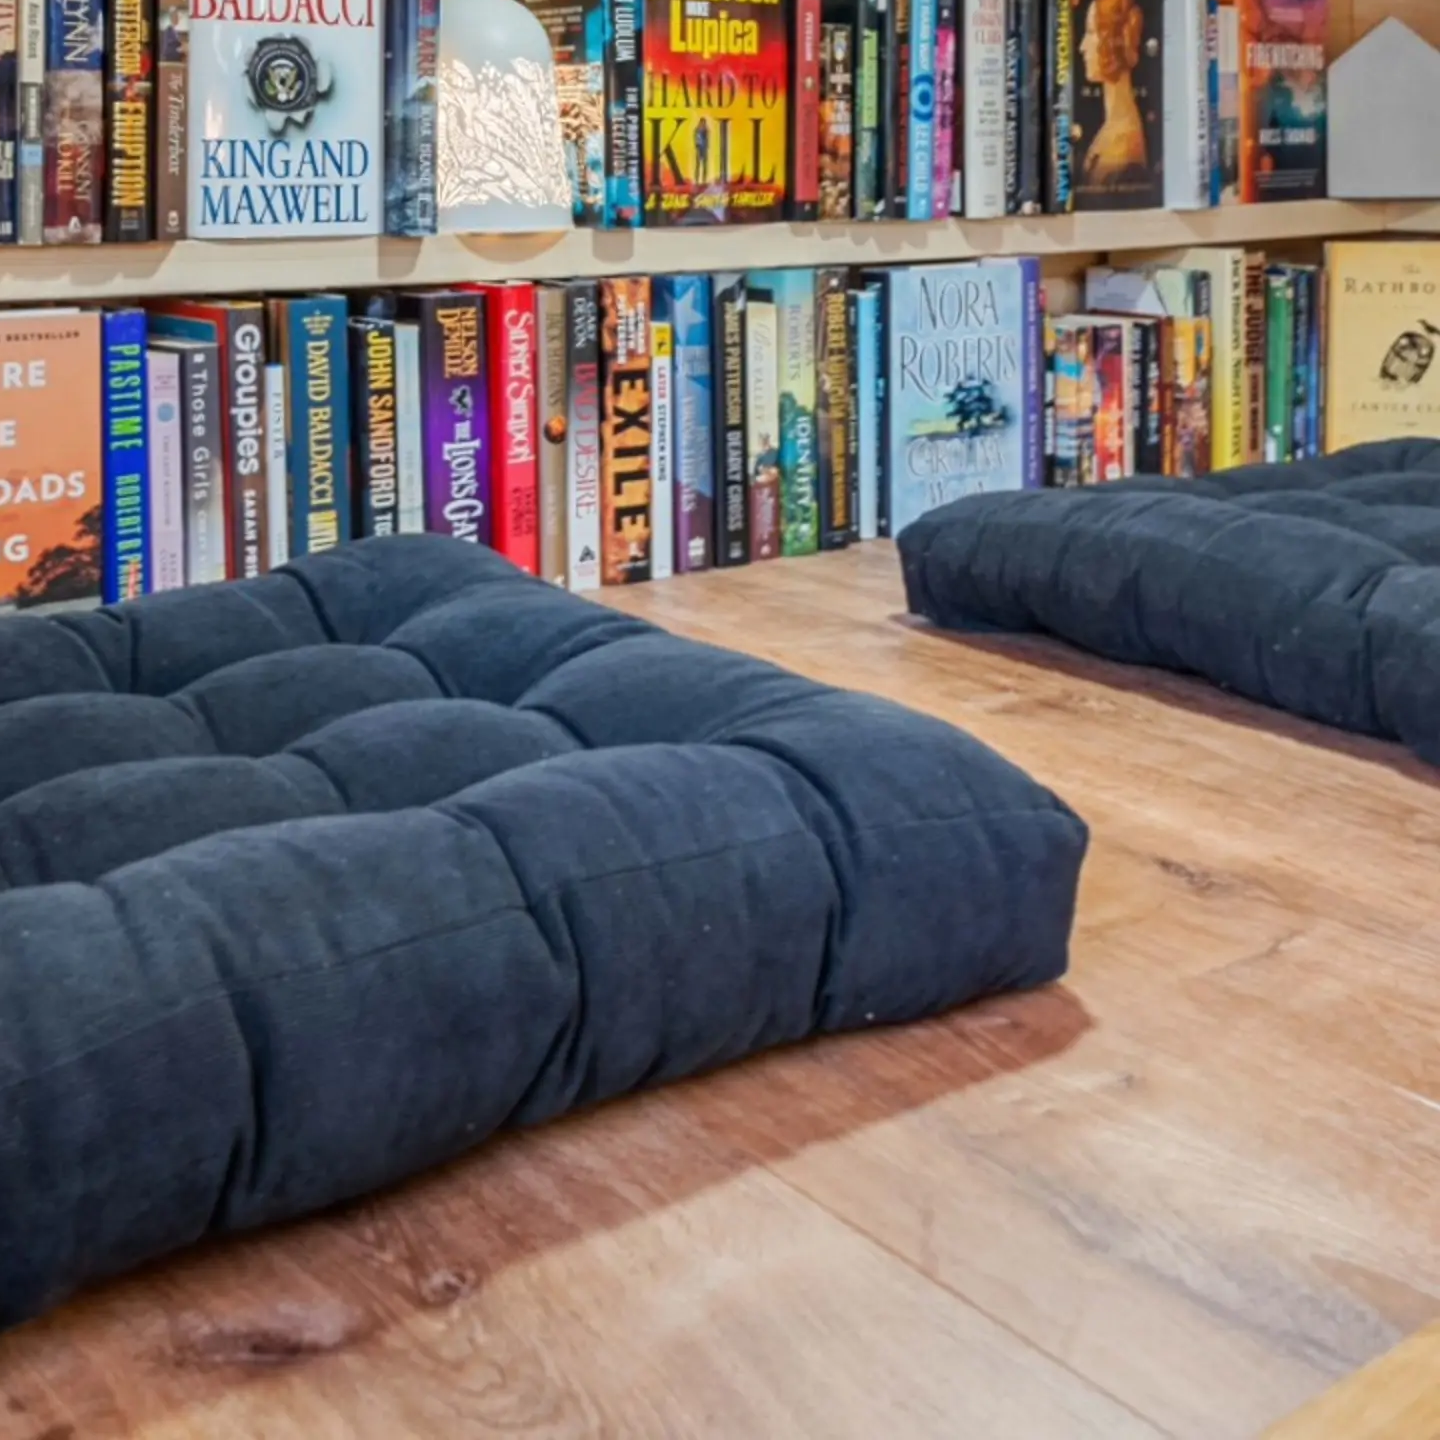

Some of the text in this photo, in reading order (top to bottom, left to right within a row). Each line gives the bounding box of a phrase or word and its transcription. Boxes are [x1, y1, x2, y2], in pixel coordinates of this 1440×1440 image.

[417, 26, 435, 79] BARR
[615, 7, 637, 62] LUDLUM
[670, 0, 759, 59] Lupica
[647, 68, 780, 110] HARD TO
[111, 101, 147, 208] ERUPTION
[167, 94, 185, 175] Tinderbox
[200, 138, 370, 180] KING AND
[645, 116, 777, 195] KILL
[200, 183, 368, 227] MAXWELL
[915, 151, 931, 194] CHILD
[919, 275, 1000, 331] NORA
[1244, 264, 1262, 300] THE
[1343, 277, 1437, 295] RATHBO
[437, 308, 459, 379] DEMILLE
[459, 306, 479, 378] NELSON
[503, 311, 535, 380] SIDNEY
[573, 296, 587, 348] DEVON
[787, 303, 802, 381] ROBERTS
[825, 293, 846, 348] ROBERT
[1244, 304, 1263, 366] JUDGE
[306, 340, 331, 402] DAVID
[365, 330, 394, 390] JOHN
[546, 311, 564, 407] JACK HIGGINS
[724, 346, 742, 425] PATTERSON
[899, 333, 1016, 402] ROBERTS
[108, 343, 144, 451] PASTIME
[230, 324, 263, 475] Groupies
[272, 392, 286, 461] FOSTER
[505, 381, 536, 465] SHELDON
[657, 366, 667, 482] LATER STEPHEN KING
[191, 370, 211, 501] Those Girls
[308, 406, 334, 506] BALDACCI
[367, 393, 396, 509] SANDFORD
[574, 363, 597, 519] BAD DESIRE
[611, 369, 651, 534] EXILE
[795, 416, 810, 508] IDENTITY
[115, 473, 142, 536] ROBERT
[725, 429, 745, 532] DEADLY CROSS
[242, 488, 258, 580] SARAH PRIS
